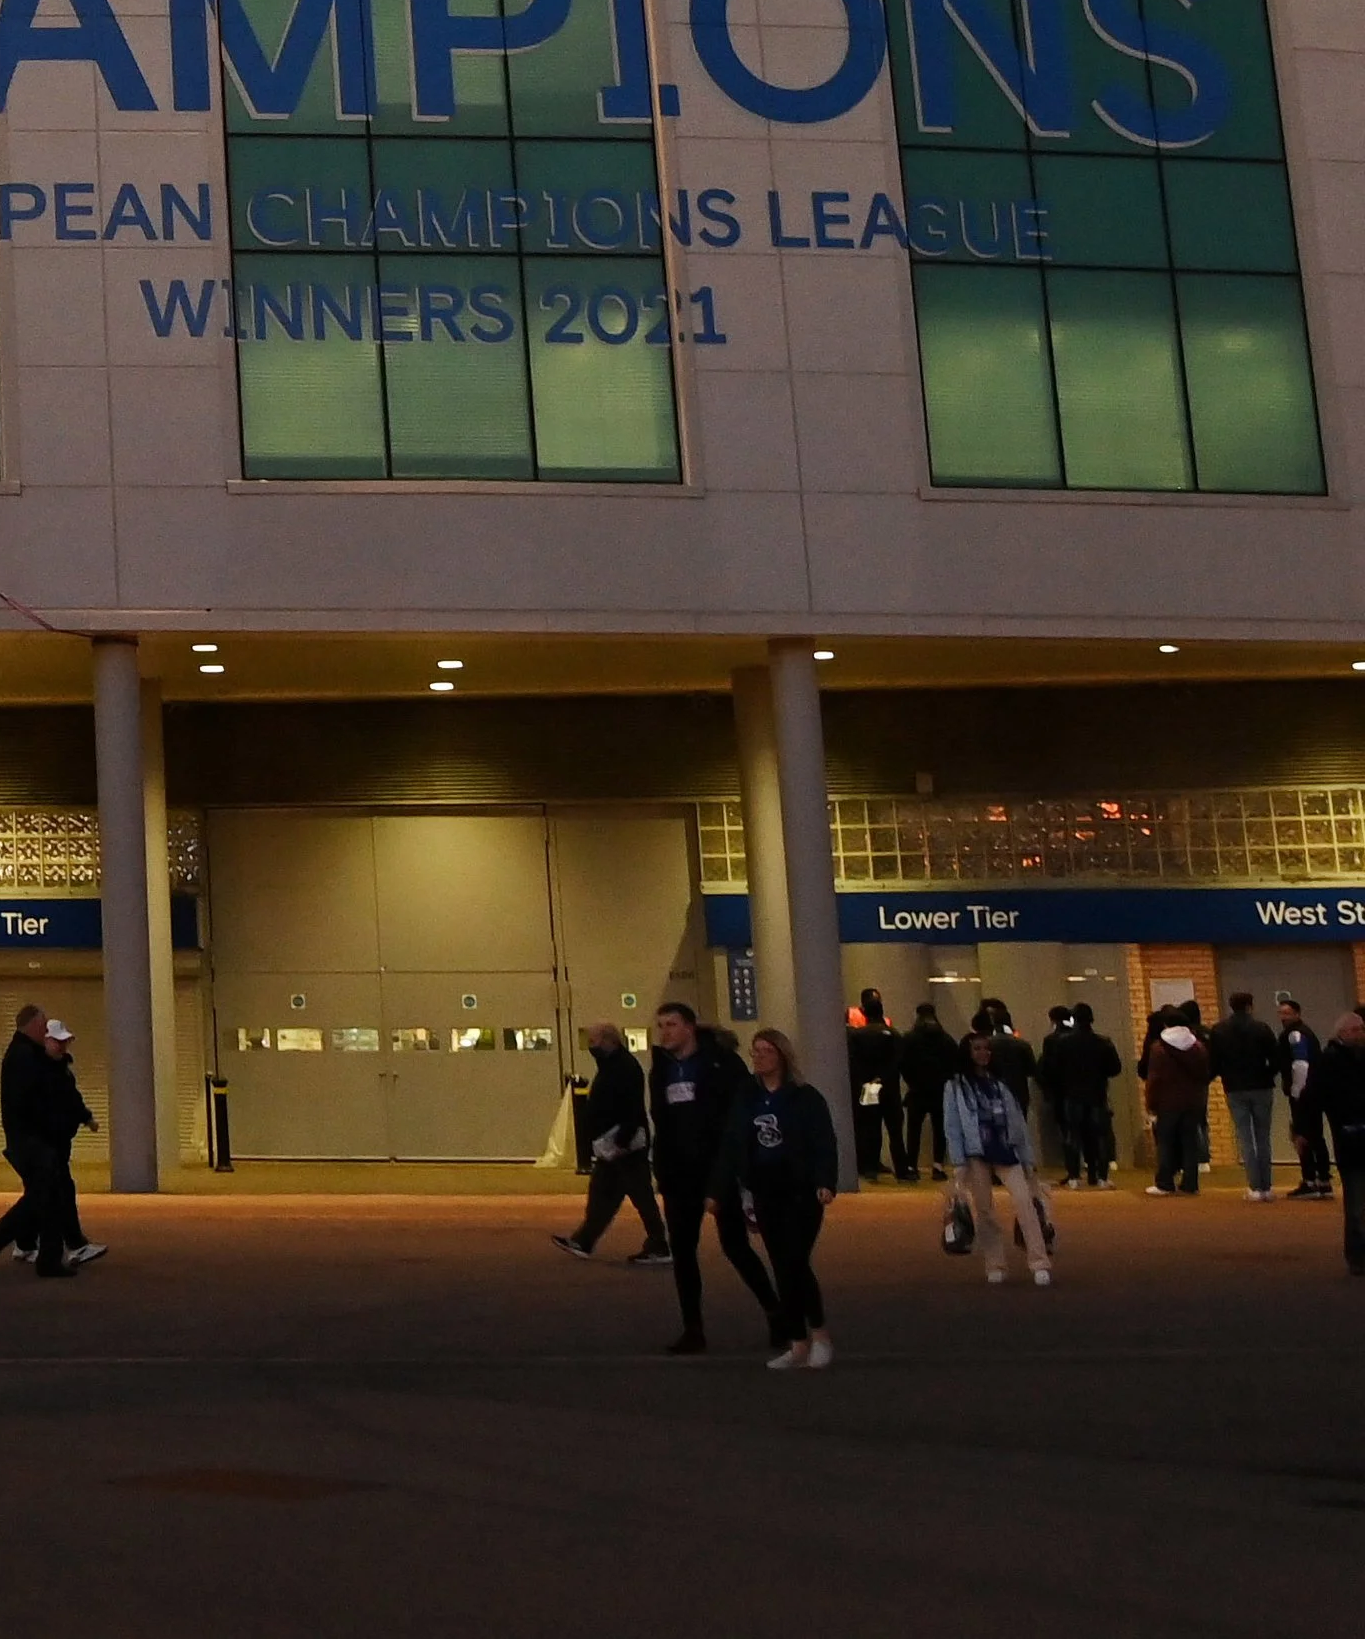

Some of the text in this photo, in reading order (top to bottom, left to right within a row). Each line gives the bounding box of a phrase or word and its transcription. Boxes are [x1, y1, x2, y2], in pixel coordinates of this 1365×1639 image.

[248, 185, 741, 250] CHAMPIONS
[769, 191, 1056, 262] LEAGUE
[139, 277, 728, 346] WINNERS 2021
[0, 912, 49, 935] Tier
[878, 905, 1020, 930] Lower Tier
[1255, 901, 1328, 925] West
